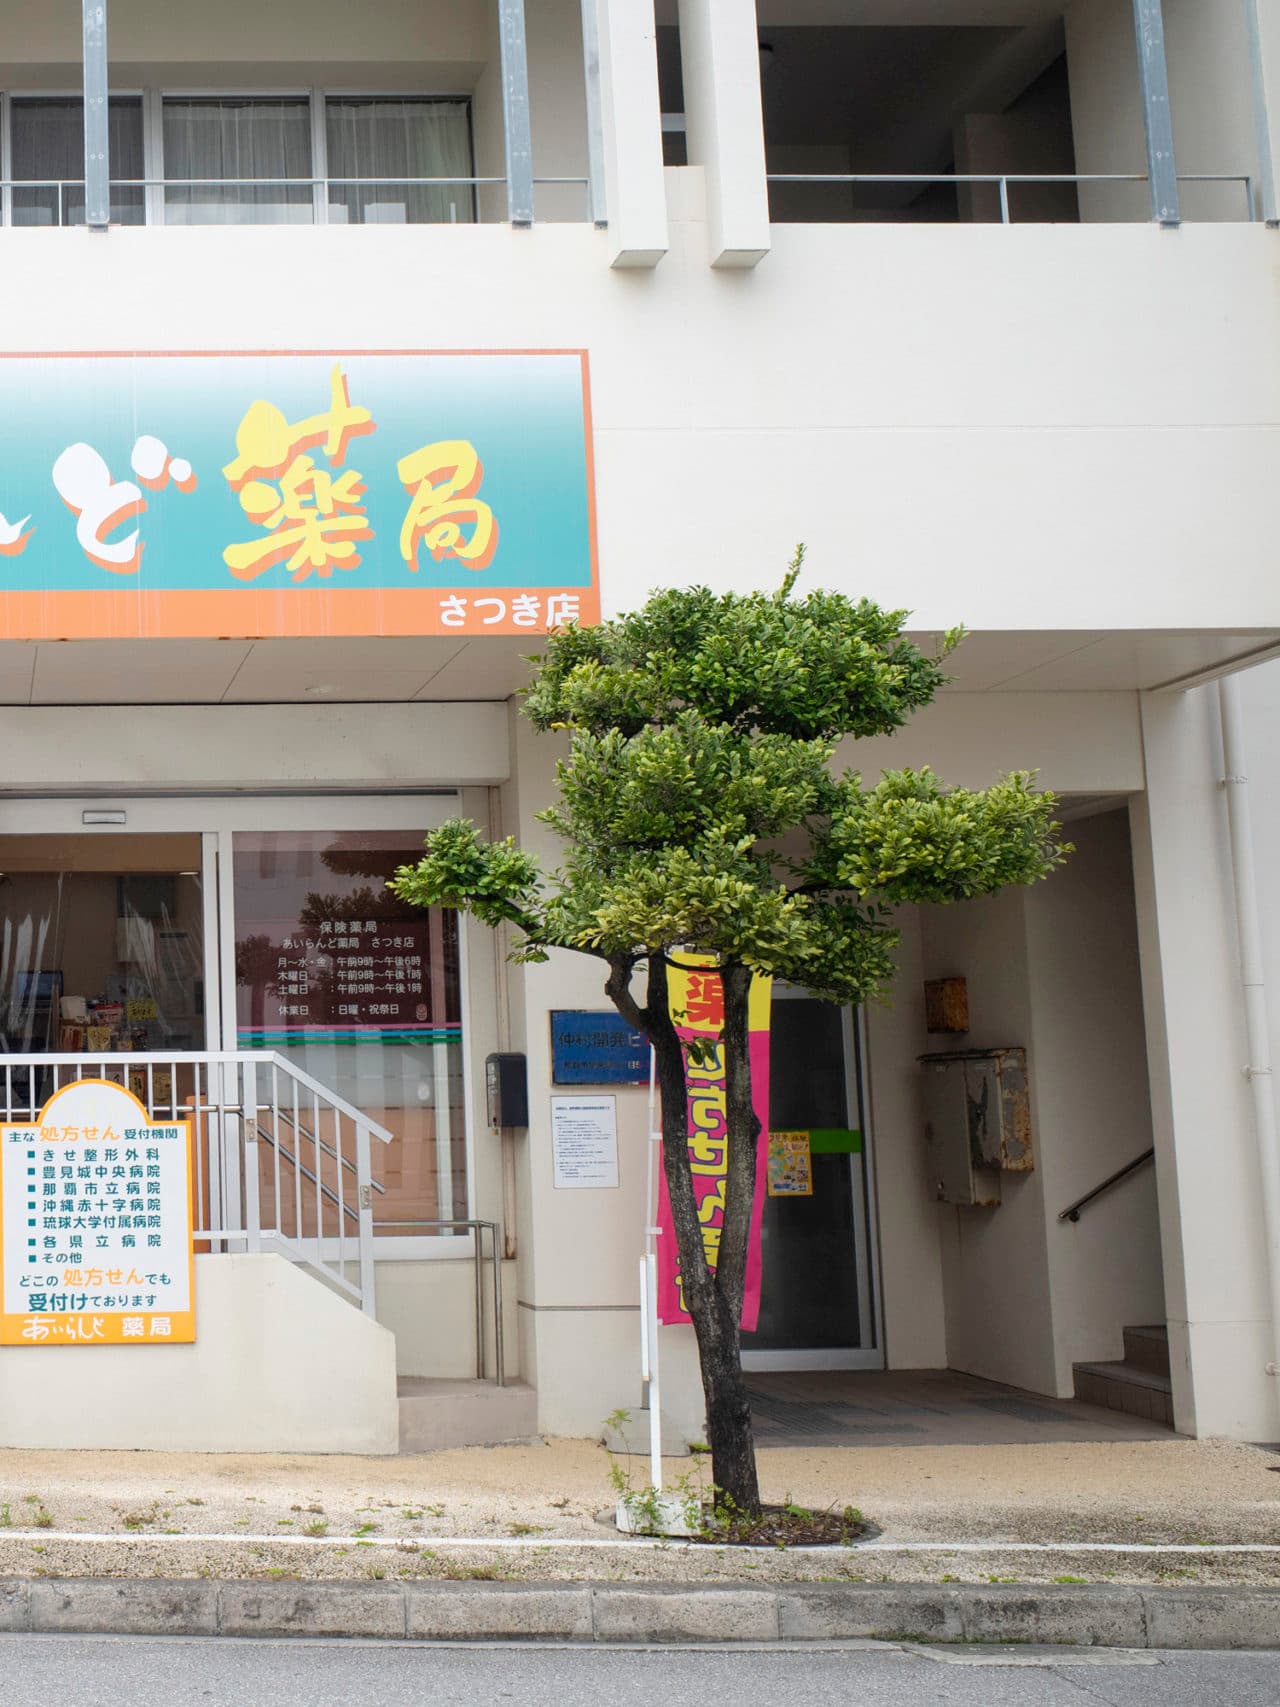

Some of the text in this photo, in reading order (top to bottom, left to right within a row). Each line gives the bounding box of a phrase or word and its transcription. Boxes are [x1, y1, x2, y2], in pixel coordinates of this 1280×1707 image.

[440, 594, 581, 628] さつき店
[319, 921, 378, 935] 保険薬局
[282, 936, 415, 949] あいらんど薬局 さつき店
[277, 970, 308, 982] 木曜日
[278, 984, 309, 995] 土曜日
[278, 1005, 309, 1016] 休業日
[43, 1148, 161, 1162] きせ整形外科
[43, 1165, 161, 1179] 豊見城中央病院
[43, 1182, 161, 1196] 那覇市立病院
[43, 1198, 161, 1212] 沖縄赤十字病院
[43, 1215, 162, 1229] 琉球大学付属病院
[43, 1234, 162, 1248] 各県立病院
[42, 1252, 83, 1264] その他
[28, 1293, 157, 1313] 受付けております
[121, 1316, 172, 1337] 薬局
